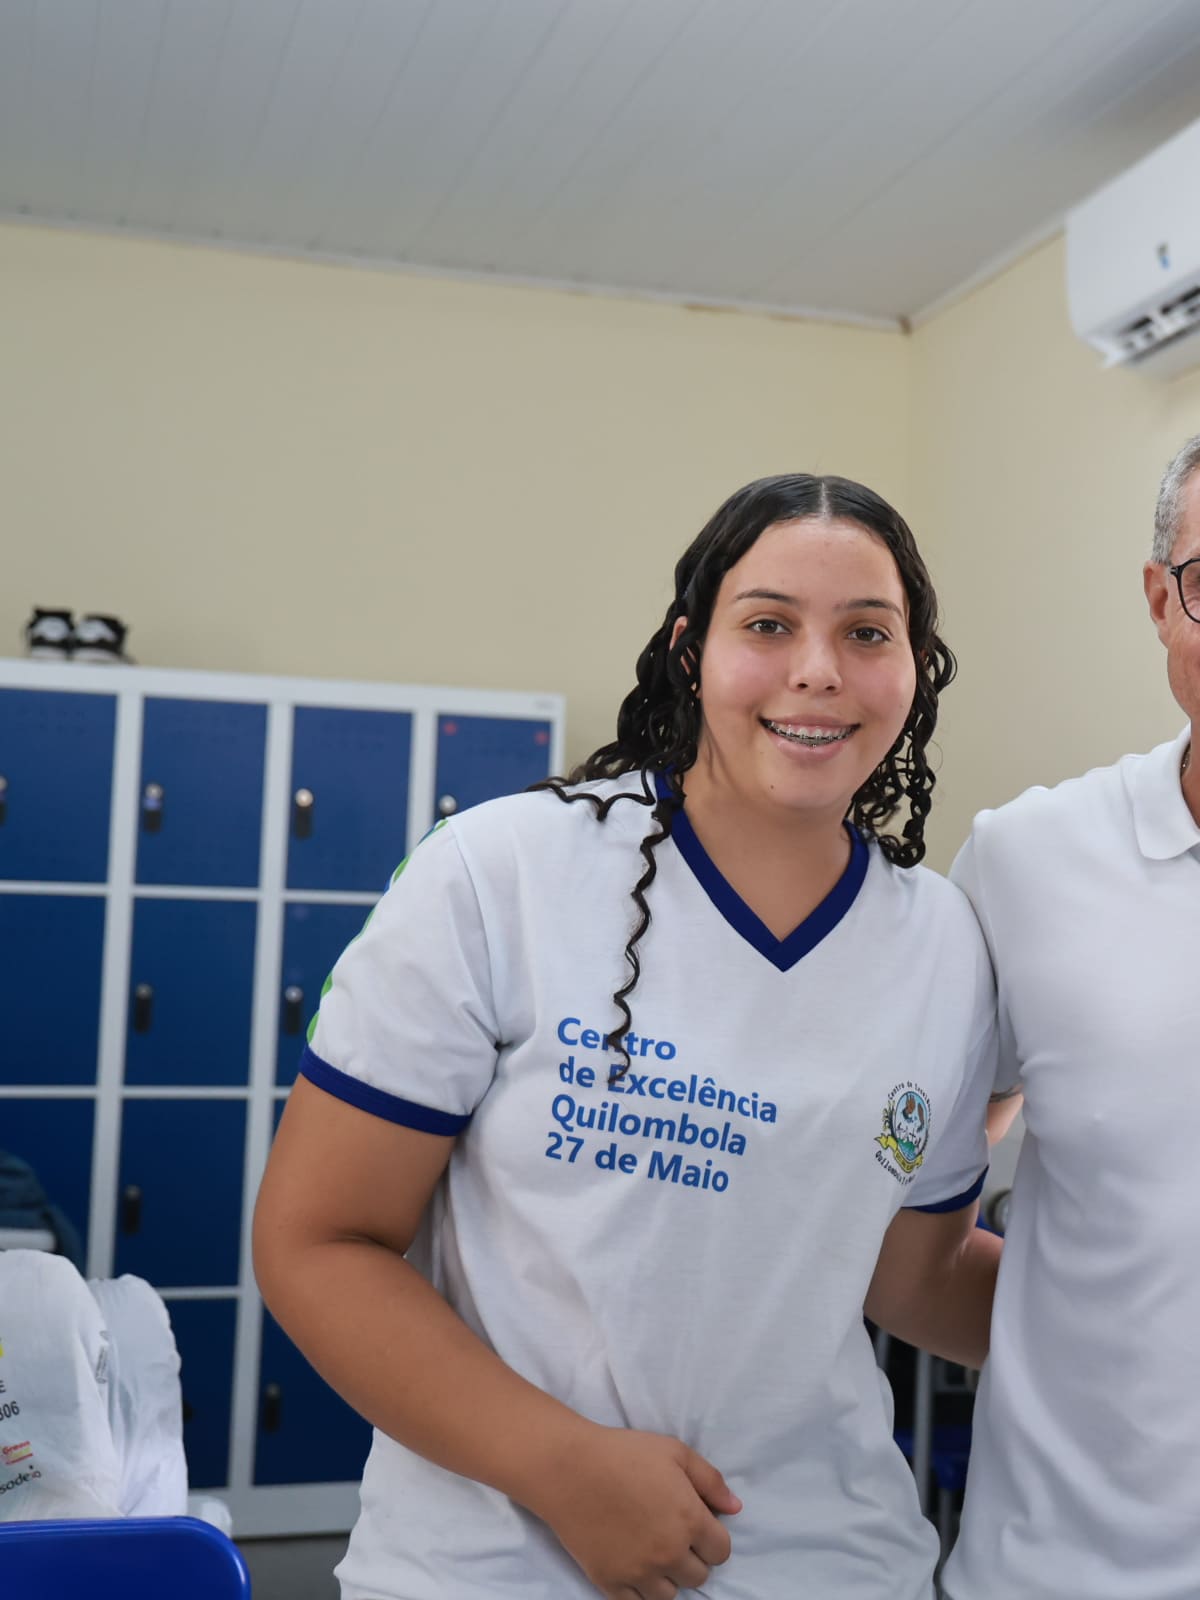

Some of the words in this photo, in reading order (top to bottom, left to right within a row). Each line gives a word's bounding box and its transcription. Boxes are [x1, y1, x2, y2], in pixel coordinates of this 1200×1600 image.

[559, 1056, 595, 1088] de
[607, 1063, 777, 1124] Excelência
[551, 1094, 747, 1156] Quilombola
[545, 1131, 585, 1164] 27
[594, 1143, 638, 1174] de
[647, 1150, 729, 1193] Maio
